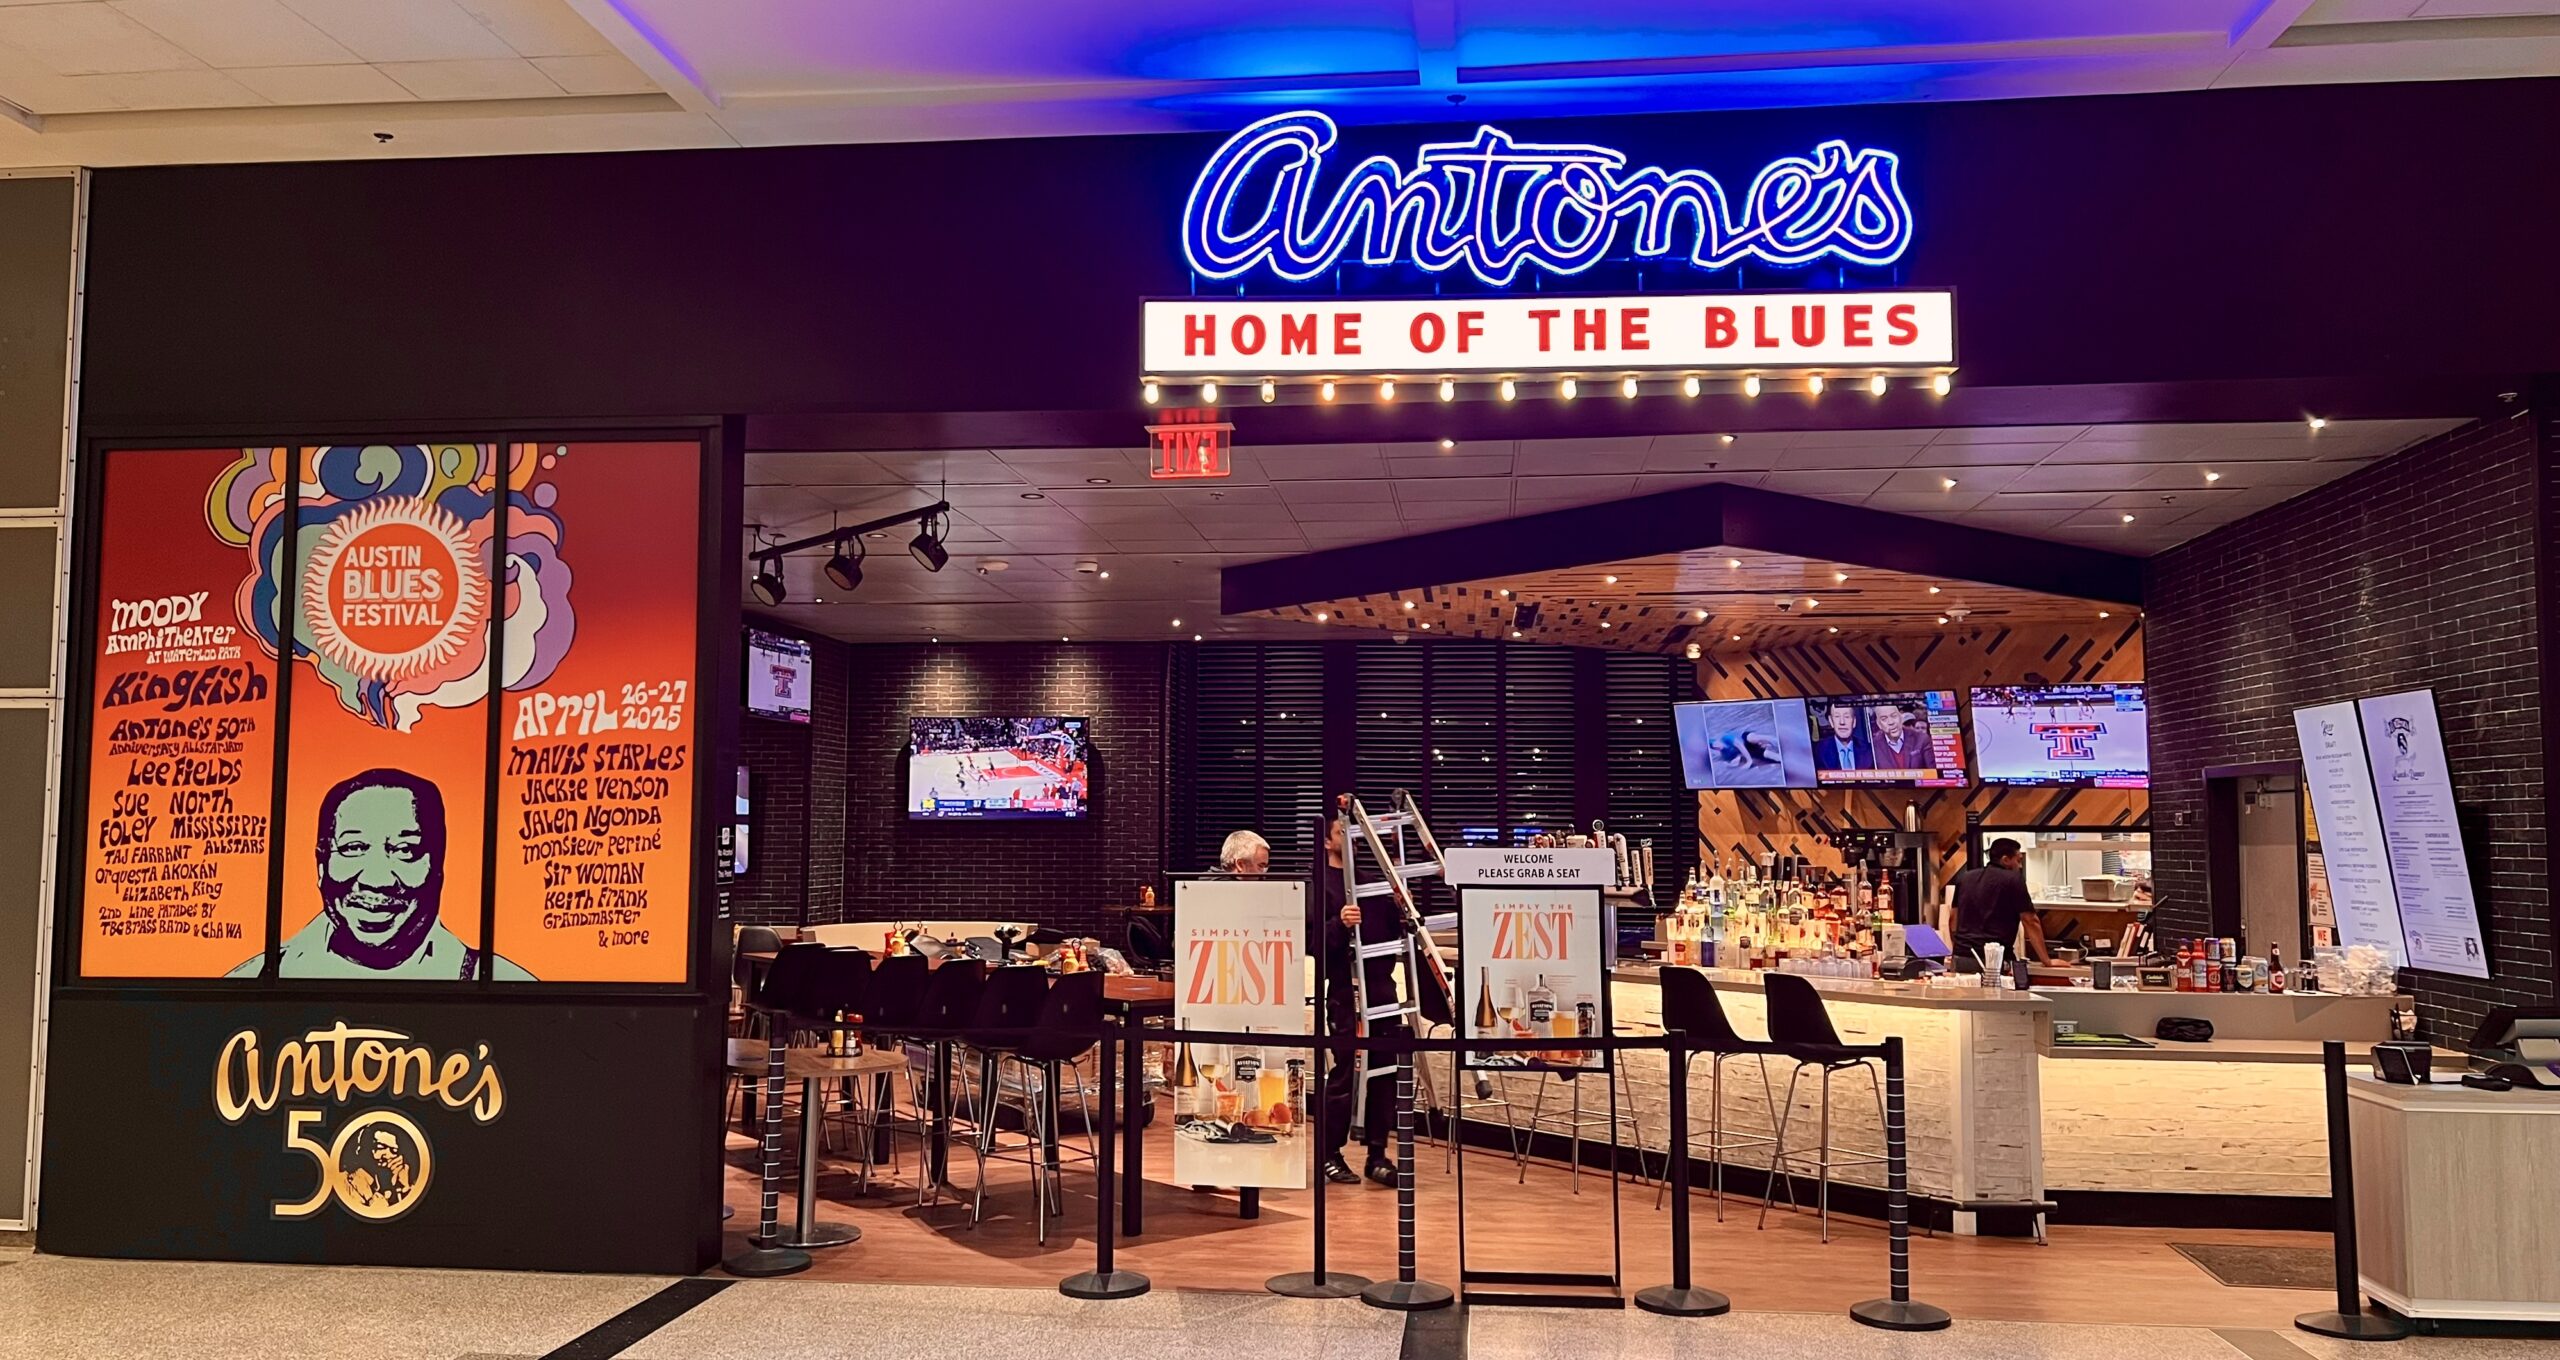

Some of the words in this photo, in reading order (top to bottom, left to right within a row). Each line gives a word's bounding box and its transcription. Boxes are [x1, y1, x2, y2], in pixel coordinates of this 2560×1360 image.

[1183, 312, 1363, 357] HOME
[1409, 309, 1486, 355] OF
[1528, 307, 1652, 353] THE
[1704, 303, 1920, 350] BLUES
[344, 545, 422, 568] AUSTIN
[343, 568, 444, 603] BLUES
[342, 603, 444, 627] FESTIVAL
[146, 650, 162, 665] AT
[621, 680, 688, 705] 26-27
[622, 704, 682, 731] 2025
[104, 849, 128, 865] TAJ
[131, 845, 193, 864] FARRANT
[203, 838, 265, 855] ALLSTARS
[1504, 854, 1554, 864] WELCOME
[1478, 868, 1515, 879] PLEASE
[1517, 868, 1544, 879] GRAB
[1547, 869, 1554, 878] A
[1556, 868, 1580, 878] SEAT
[201, 902, 217, 918] BY
[225, 922, 243, 939] WA
[598, 930, 608, 949] &
[611, 930, 649, 946] more
[1192, 929, 1249, 937] SIMPLY
[1264, 929, 1292, 938] THE
[1491, 911, 1573, 960] ZEST
[1187, 940, 1294, 1006] ZEST
[275, 1110, 431, 1219] 50
